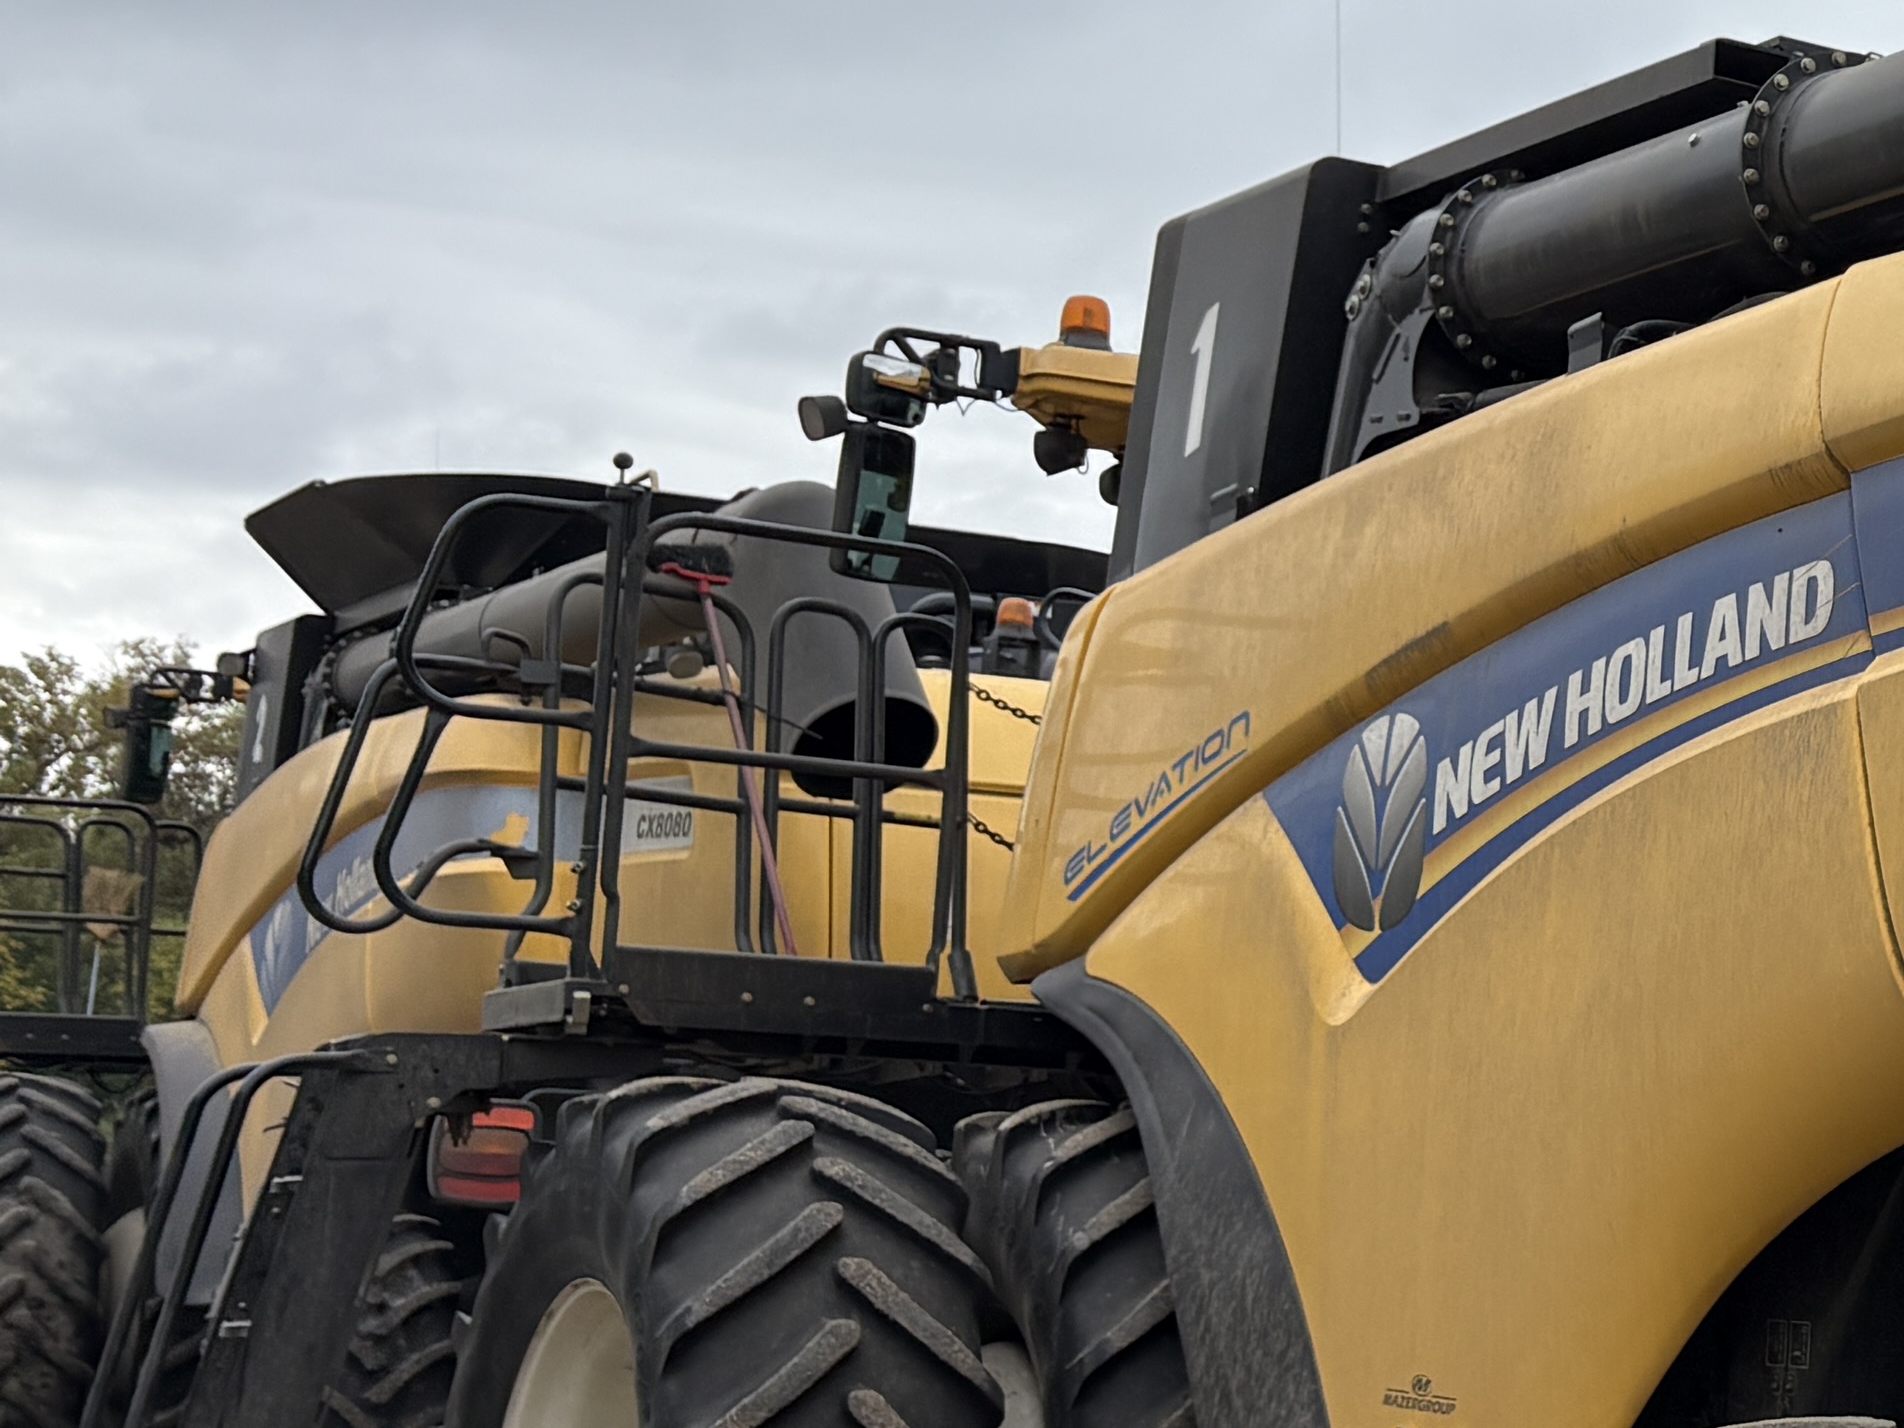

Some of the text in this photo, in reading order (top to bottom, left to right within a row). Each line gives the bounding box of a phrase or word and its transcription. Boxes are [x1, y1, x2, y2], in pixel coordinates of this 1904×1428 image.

[1184, 302, 1220, 458] 1
[1430, 558, 1836, 836] NEW HOLLAND
[636, 811, 692, 839] CX8080
[1063, 709, 1251, 887] ELEVATION
[1382, 1393, 1456, 1415] MAZERGROUP
